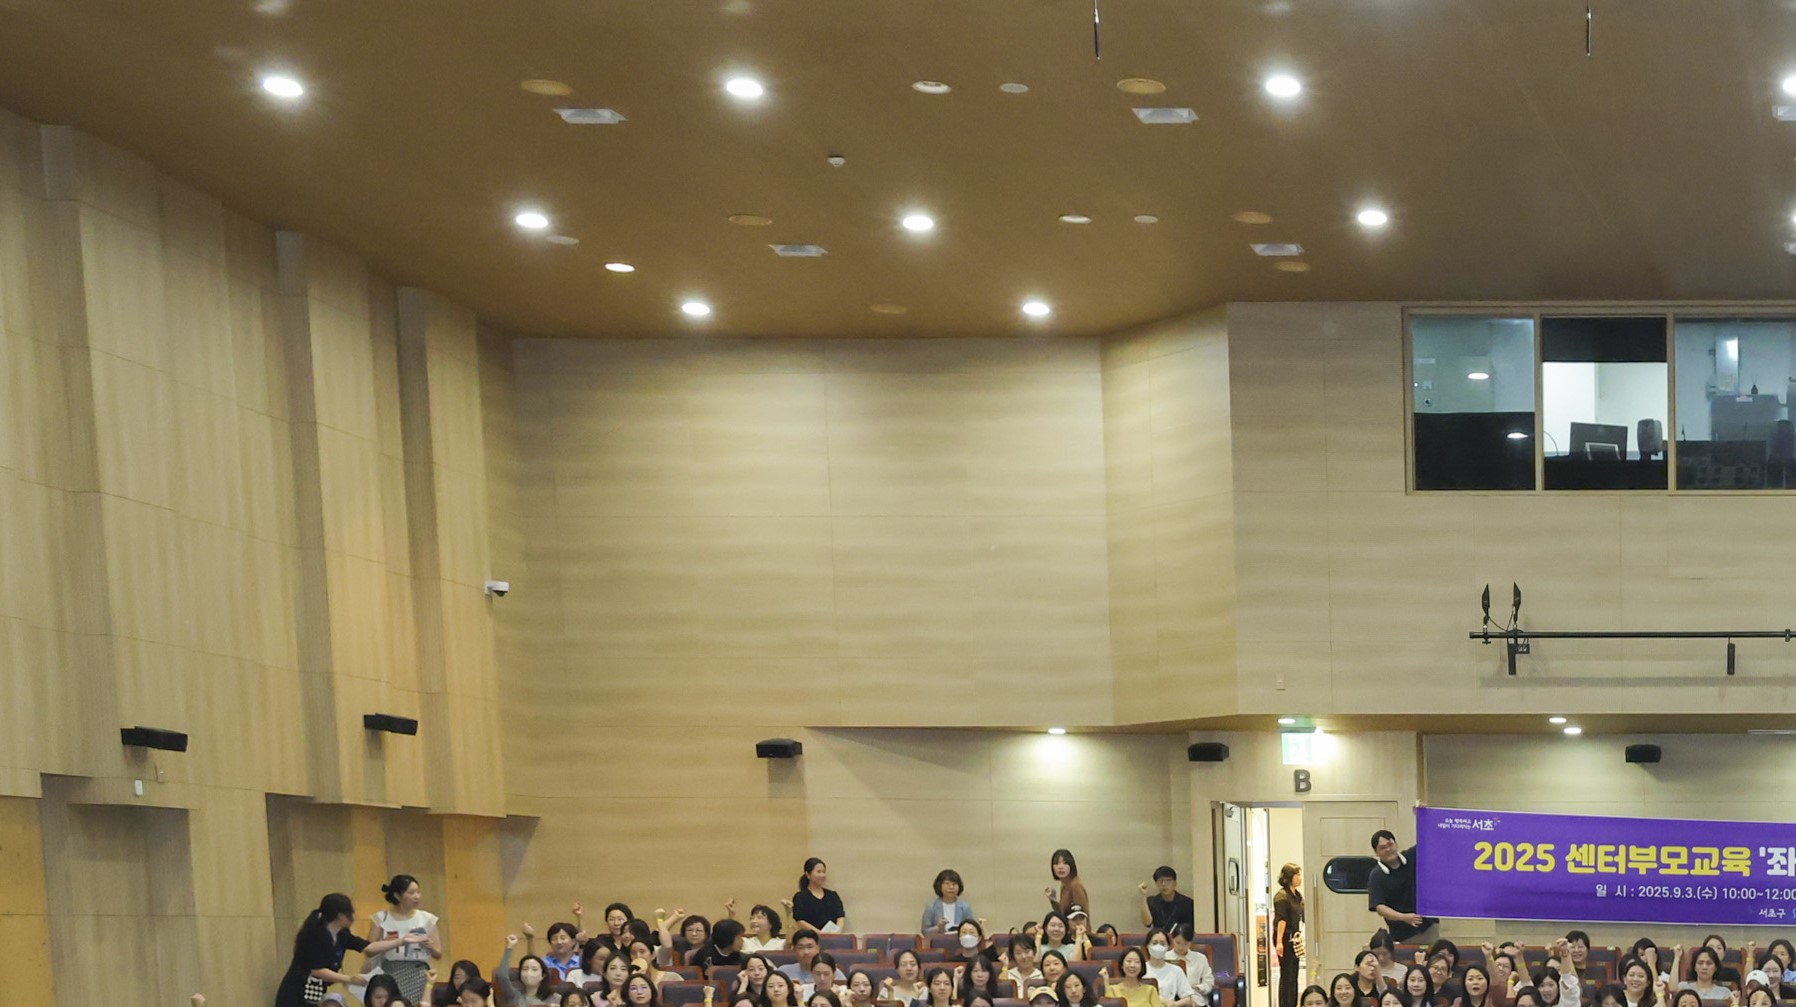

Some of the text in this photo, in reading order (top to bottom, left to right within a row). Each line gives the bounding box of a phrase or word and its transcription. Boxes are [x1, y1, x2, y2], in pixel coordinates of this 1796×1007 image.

[1294, 769, 1312, 793] B
[1472, 819, 1494, 831] 서초
[1473, 841, 1556, 872] 2025
[1565, 843, 1751, 877] 센터부모교육
[1595, 884, 1607, 898] 일
[1638, 885, 1718, 901] 2025.9.3.(수)
[1759, 908, 1786, 918] 서초구
